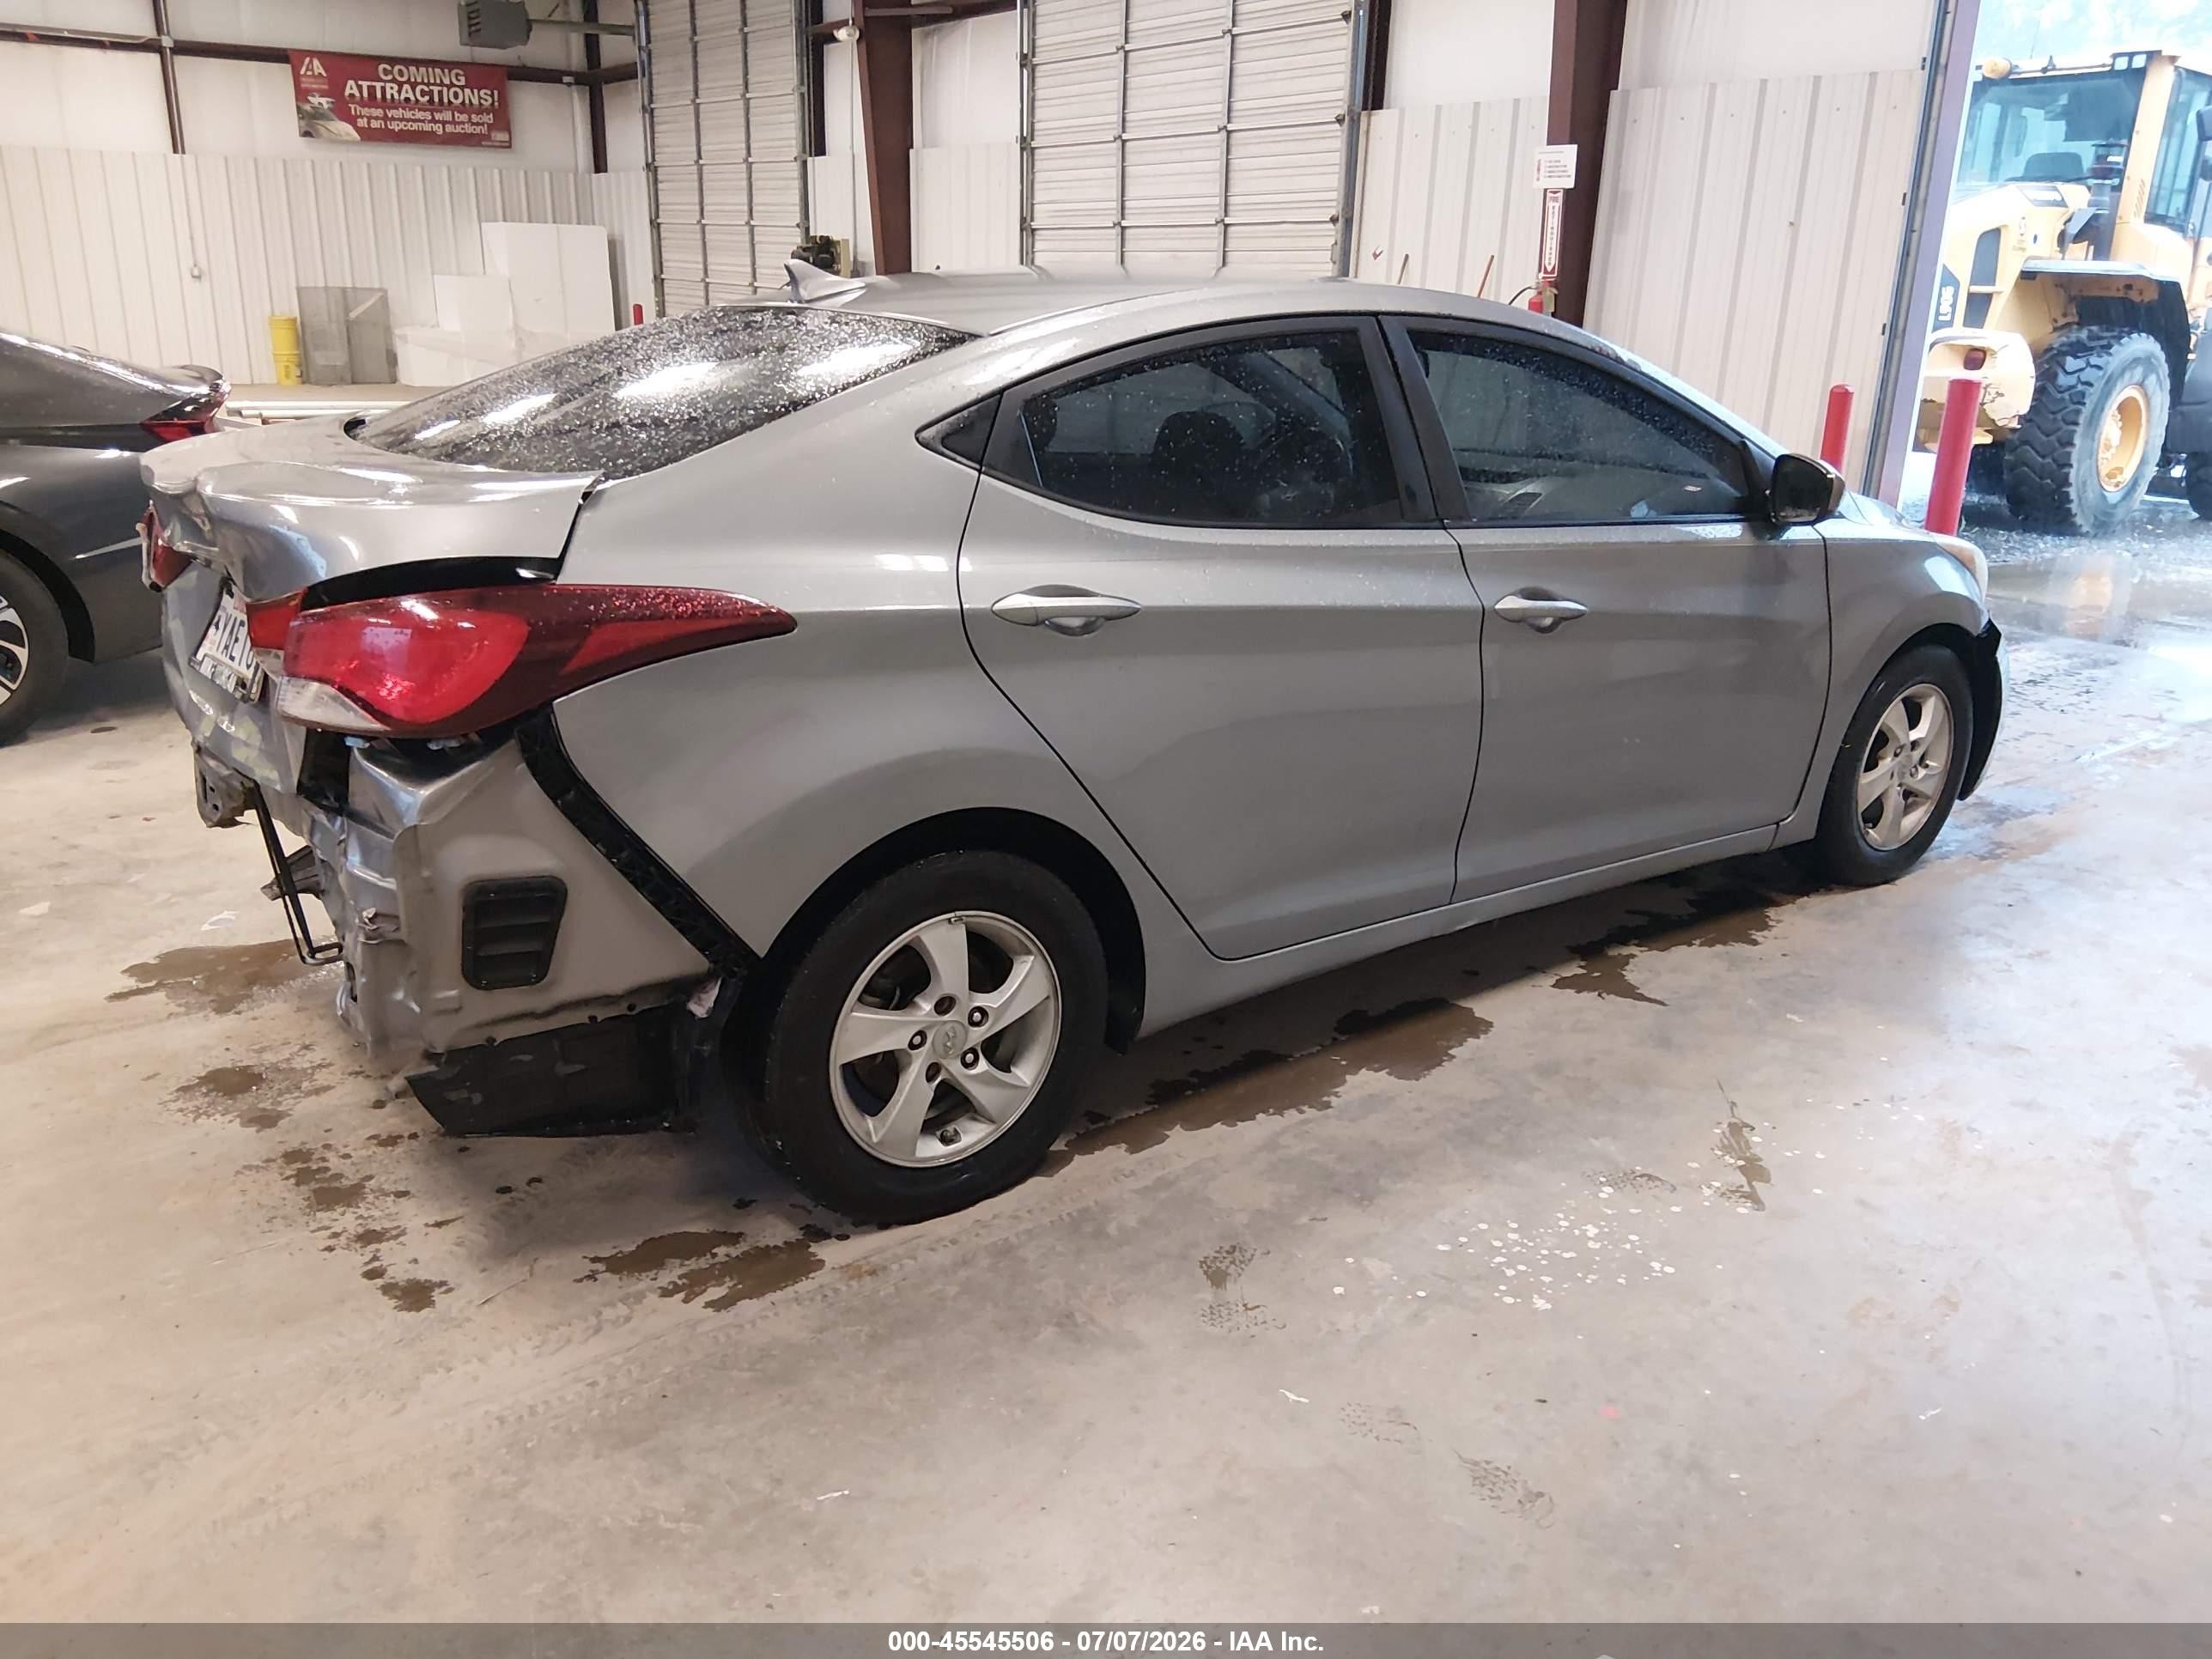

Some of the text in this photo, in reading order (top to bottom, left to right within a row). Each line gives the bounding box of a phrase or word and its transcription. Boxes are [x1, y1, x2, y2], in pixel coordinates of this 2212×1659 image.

[378, 64, 466, 86] COMING
[344, 80, 498, 106] ATTRACTIONS!
[349, 104, 494, 124] These vehicles will be sold
[356, 117, 489, 135] at an upcoming auction!
